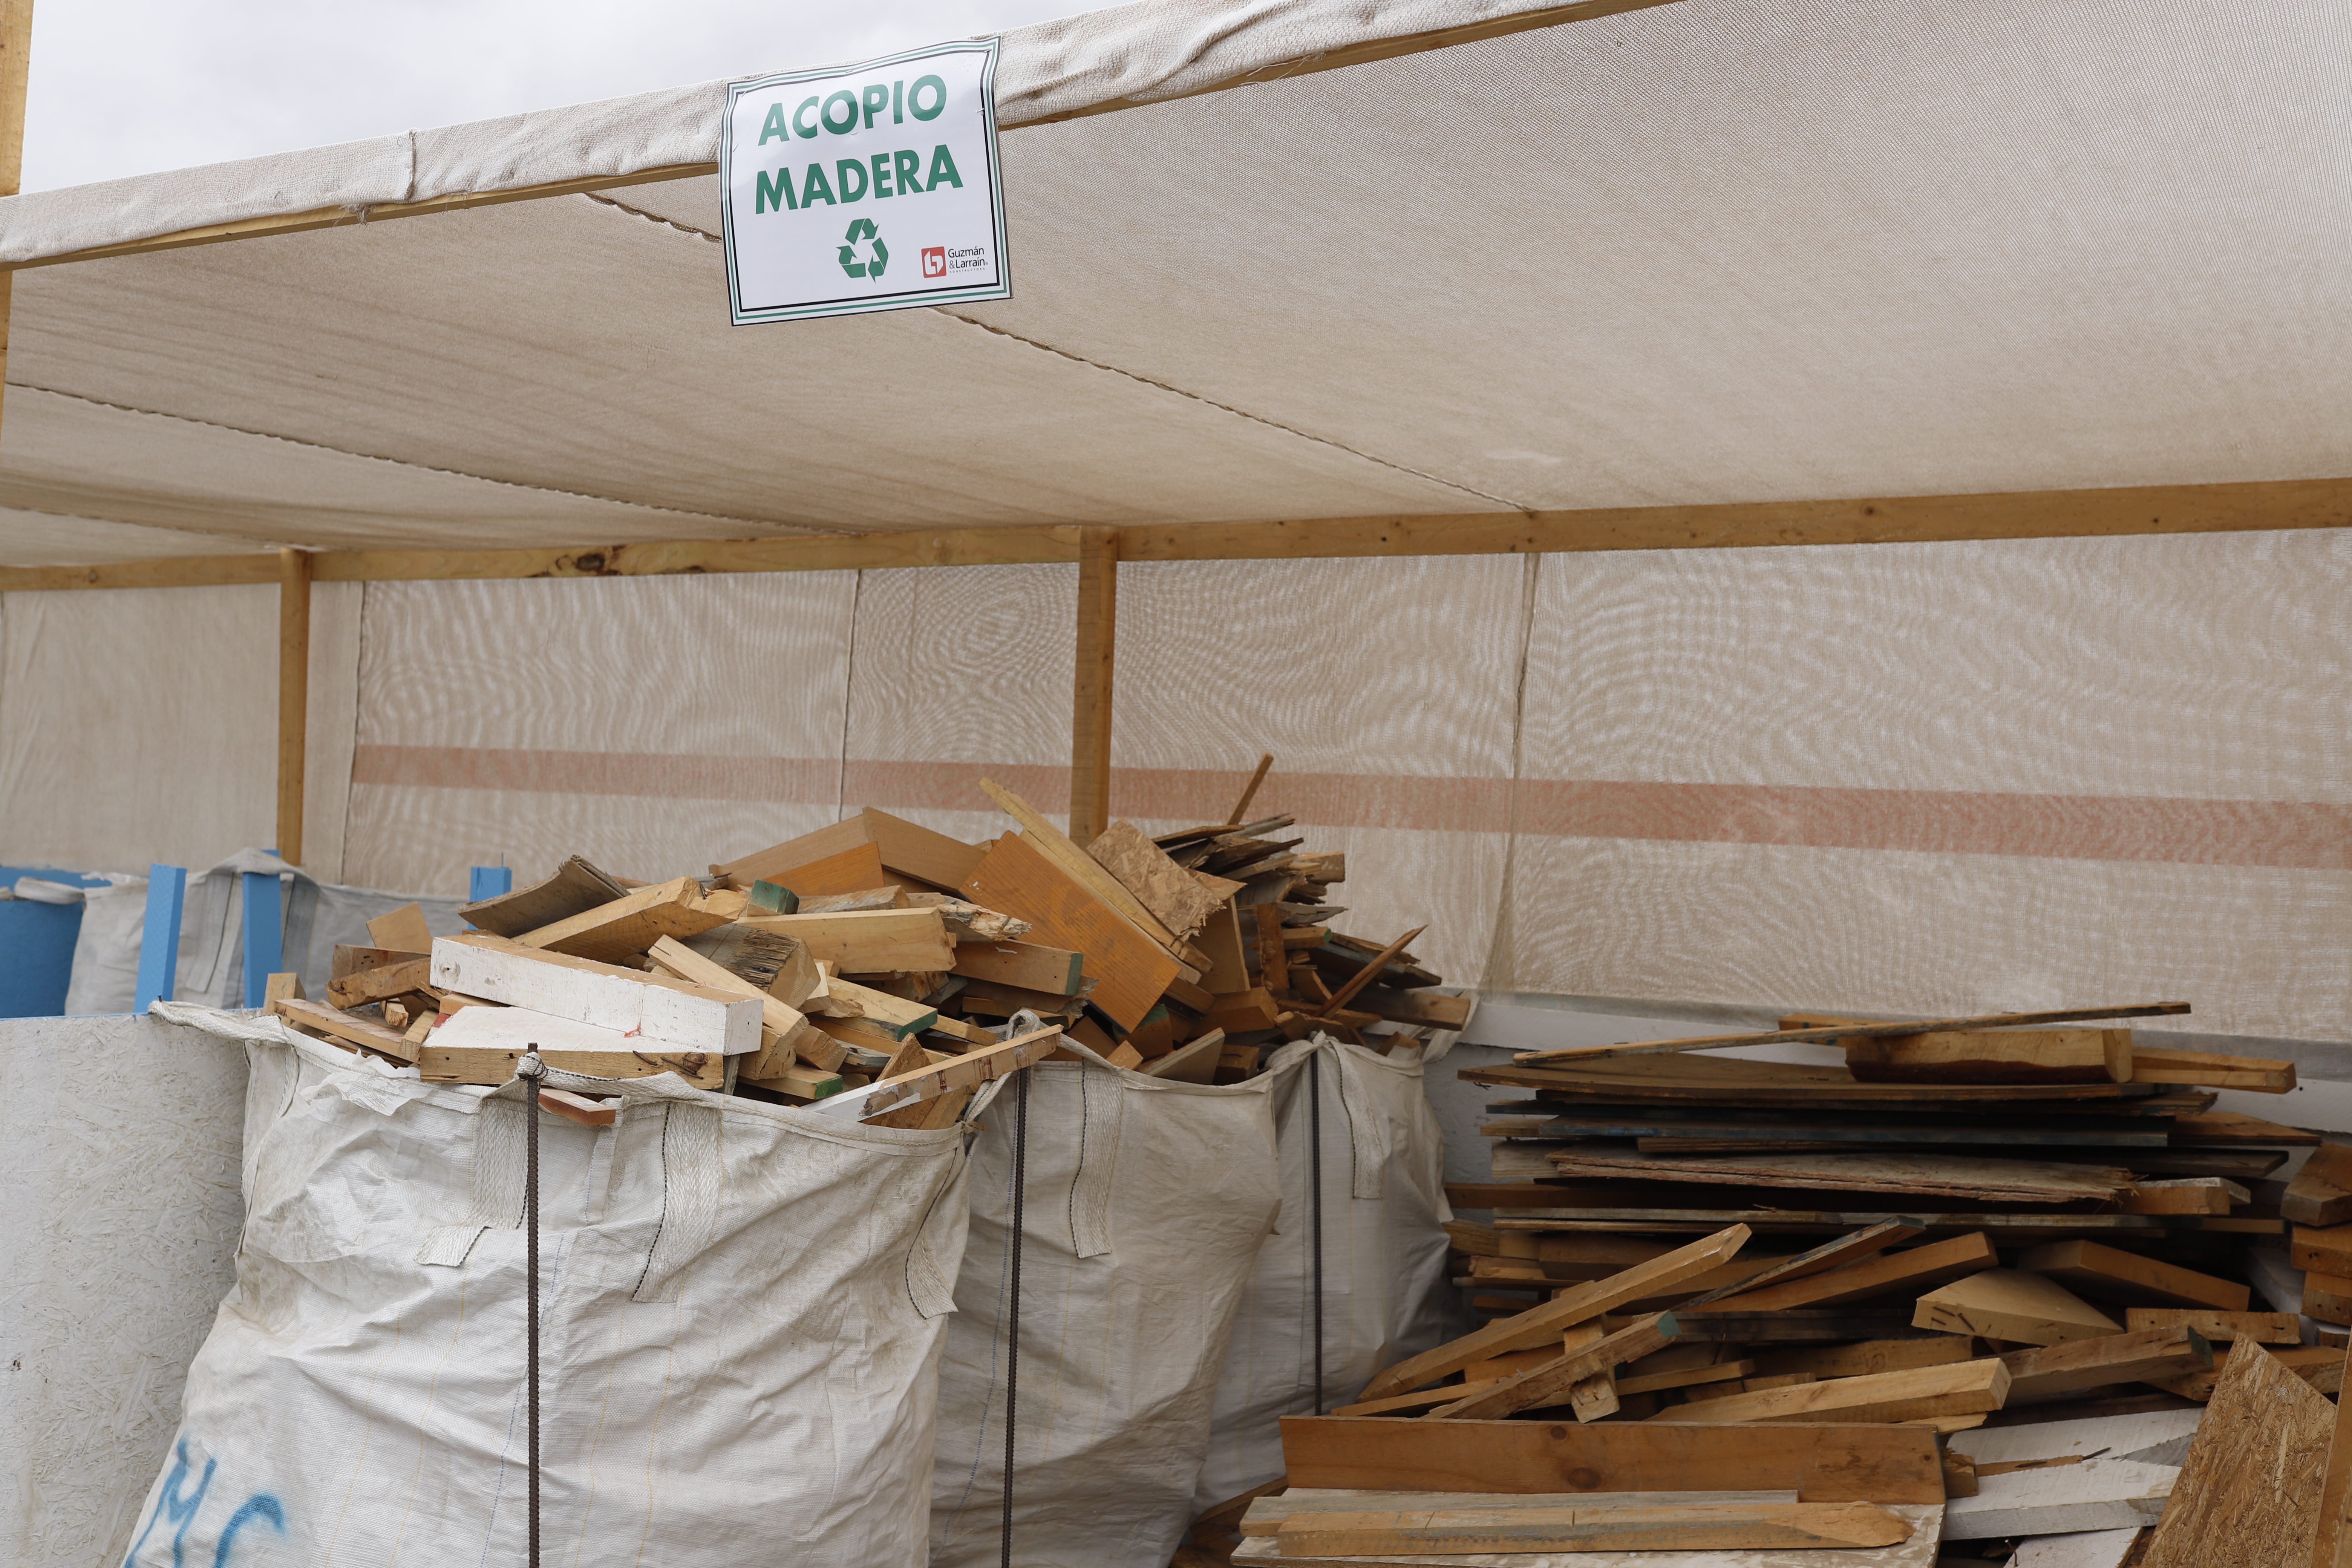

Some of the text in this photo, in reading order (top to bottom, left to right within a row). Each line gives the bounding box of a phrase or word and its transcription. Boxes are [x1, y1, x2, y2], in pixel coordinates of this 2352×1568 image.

[758, 74, 947, 146] ACOPIO
[755, 144, 963, 214] MADERA
[948, 246, 984, 258] Guzmán
